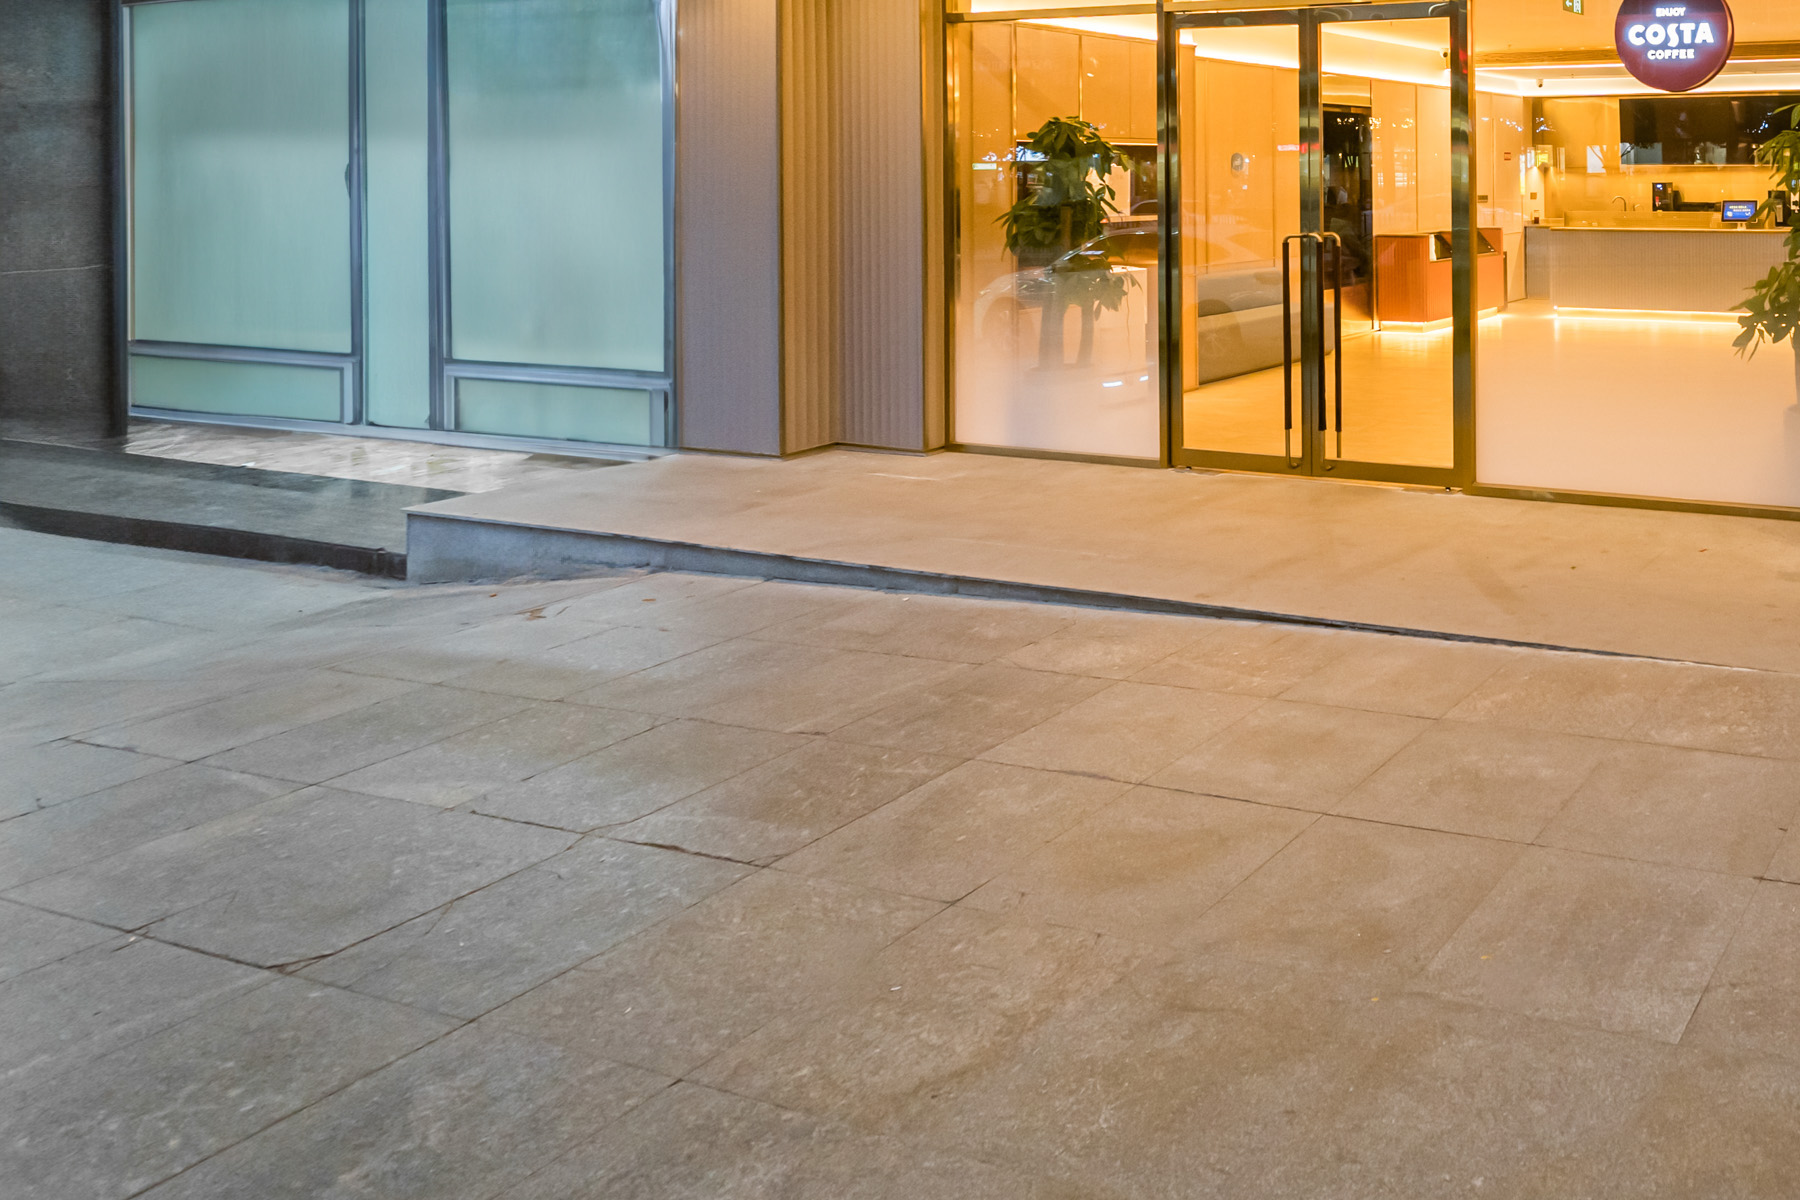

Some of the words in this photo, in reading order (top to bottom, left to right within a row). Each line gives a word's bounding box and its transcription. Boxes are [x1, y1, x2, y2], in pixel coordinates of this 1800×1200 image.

[1655, 7, 1686, 17] ENJOY
[1628, 22, 1715, 48] COSTA
[1647, 48, 1695, 60] COFFEE
